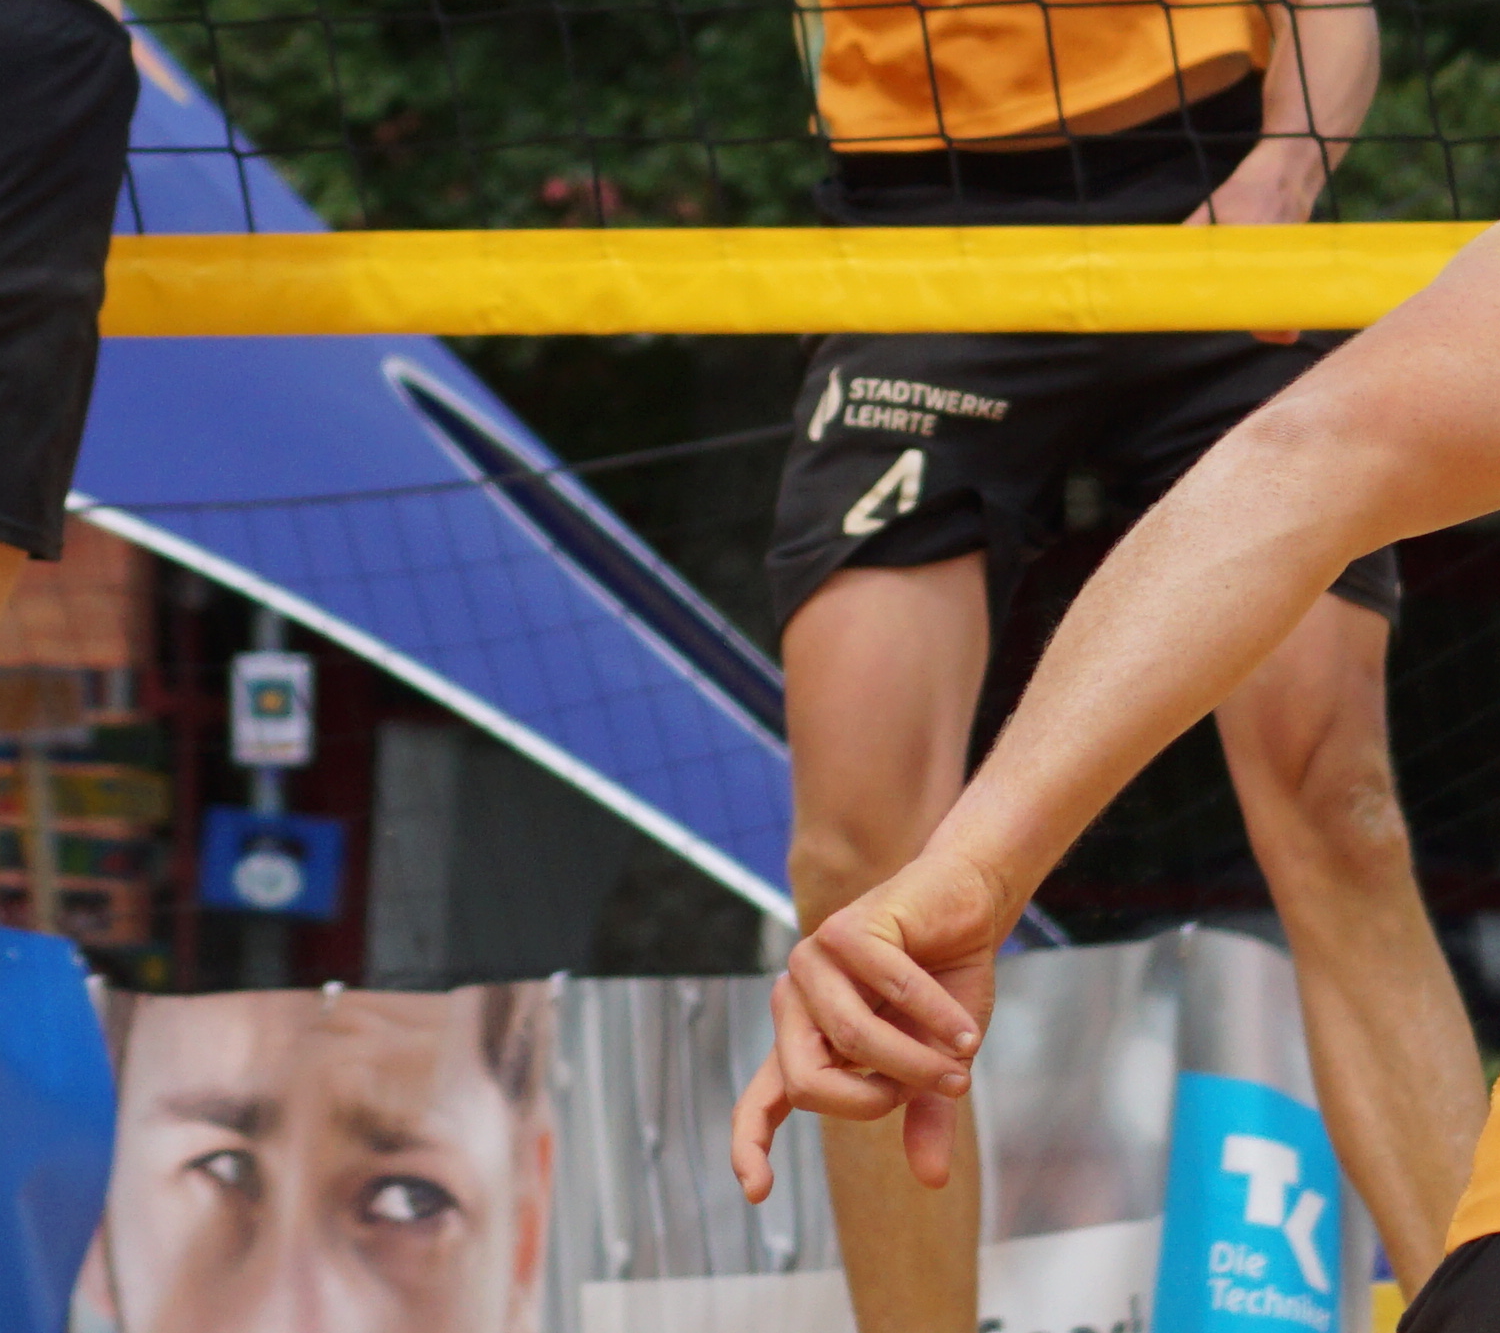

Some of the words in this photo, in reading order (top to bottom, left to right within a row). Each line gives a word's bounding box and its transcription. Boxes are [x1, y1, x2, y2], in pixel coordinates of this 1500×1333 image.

[848, 377, 1011, 421] STADTWERKE
[843, 404, 939, 437] LEHRTE
[1221, 1134, 1331, 1294] TK
[1209, 1240, 1267, 1279] Die
